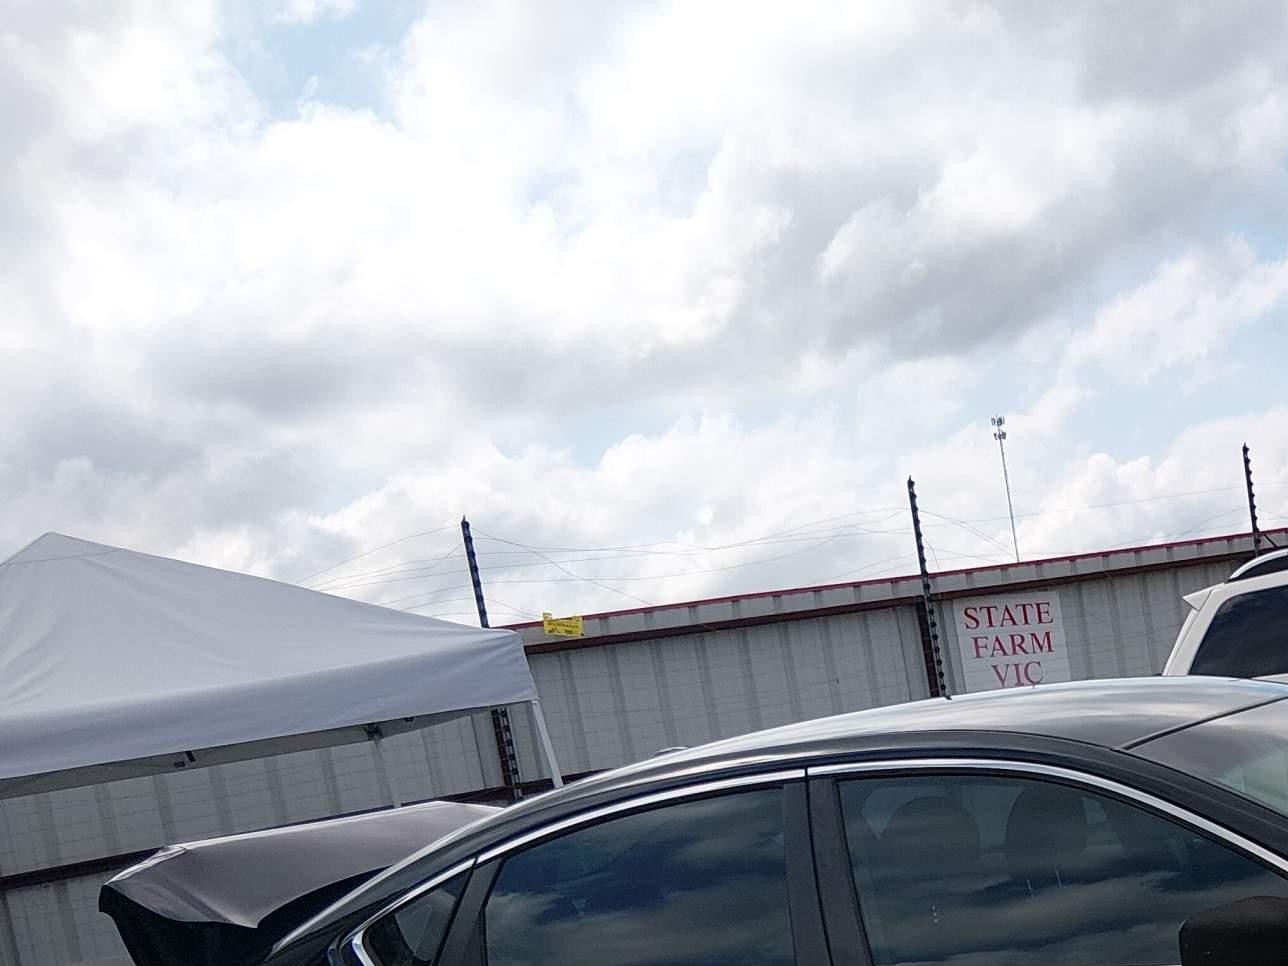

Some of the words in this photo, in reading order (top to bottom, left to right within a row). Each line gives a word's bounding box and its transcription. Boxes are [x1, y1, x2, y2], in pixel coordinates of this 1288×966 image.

[963, 602, 1054, 630] STATE
[972, 631, 1056, 659] FARM
[991, 661, 1044, 689] VIC
